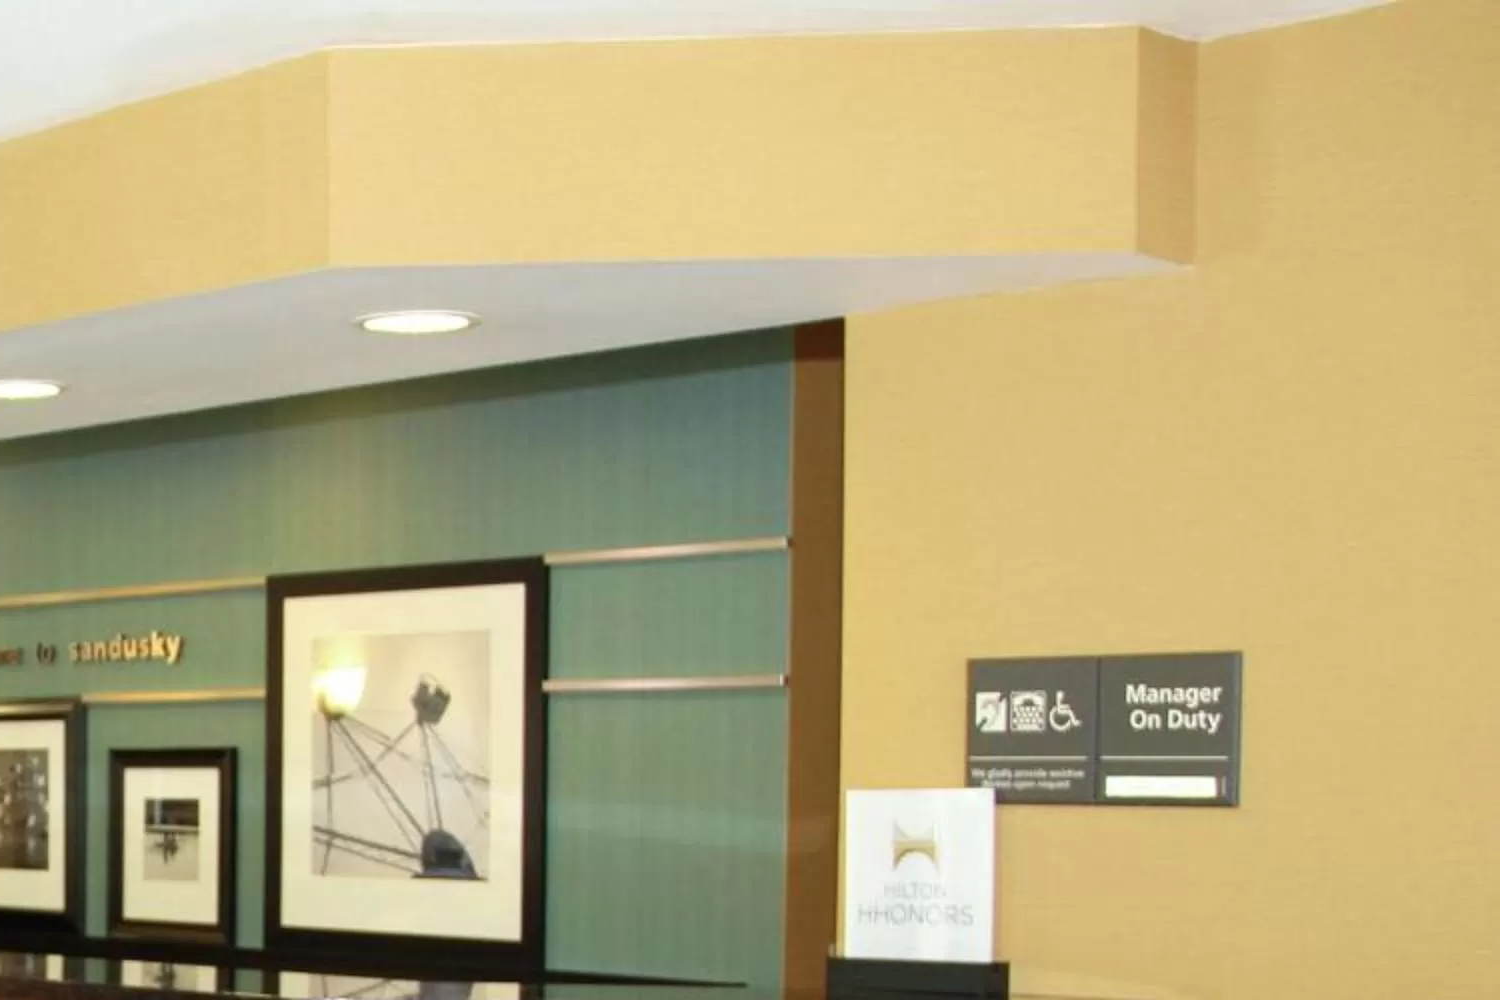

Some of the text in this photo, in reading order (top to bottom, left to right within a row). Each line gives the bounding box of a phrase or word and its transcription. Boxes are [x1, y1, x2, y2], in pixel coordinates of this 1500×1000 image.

[68, 631, 183, 665] sandusky
[1125, 683, 1223, 709] Manager
[1129, 708, 1222, 735] On Duty
[883, 881, 947, 900] HILTON
[857, 904, 975, 927] HHONORS
